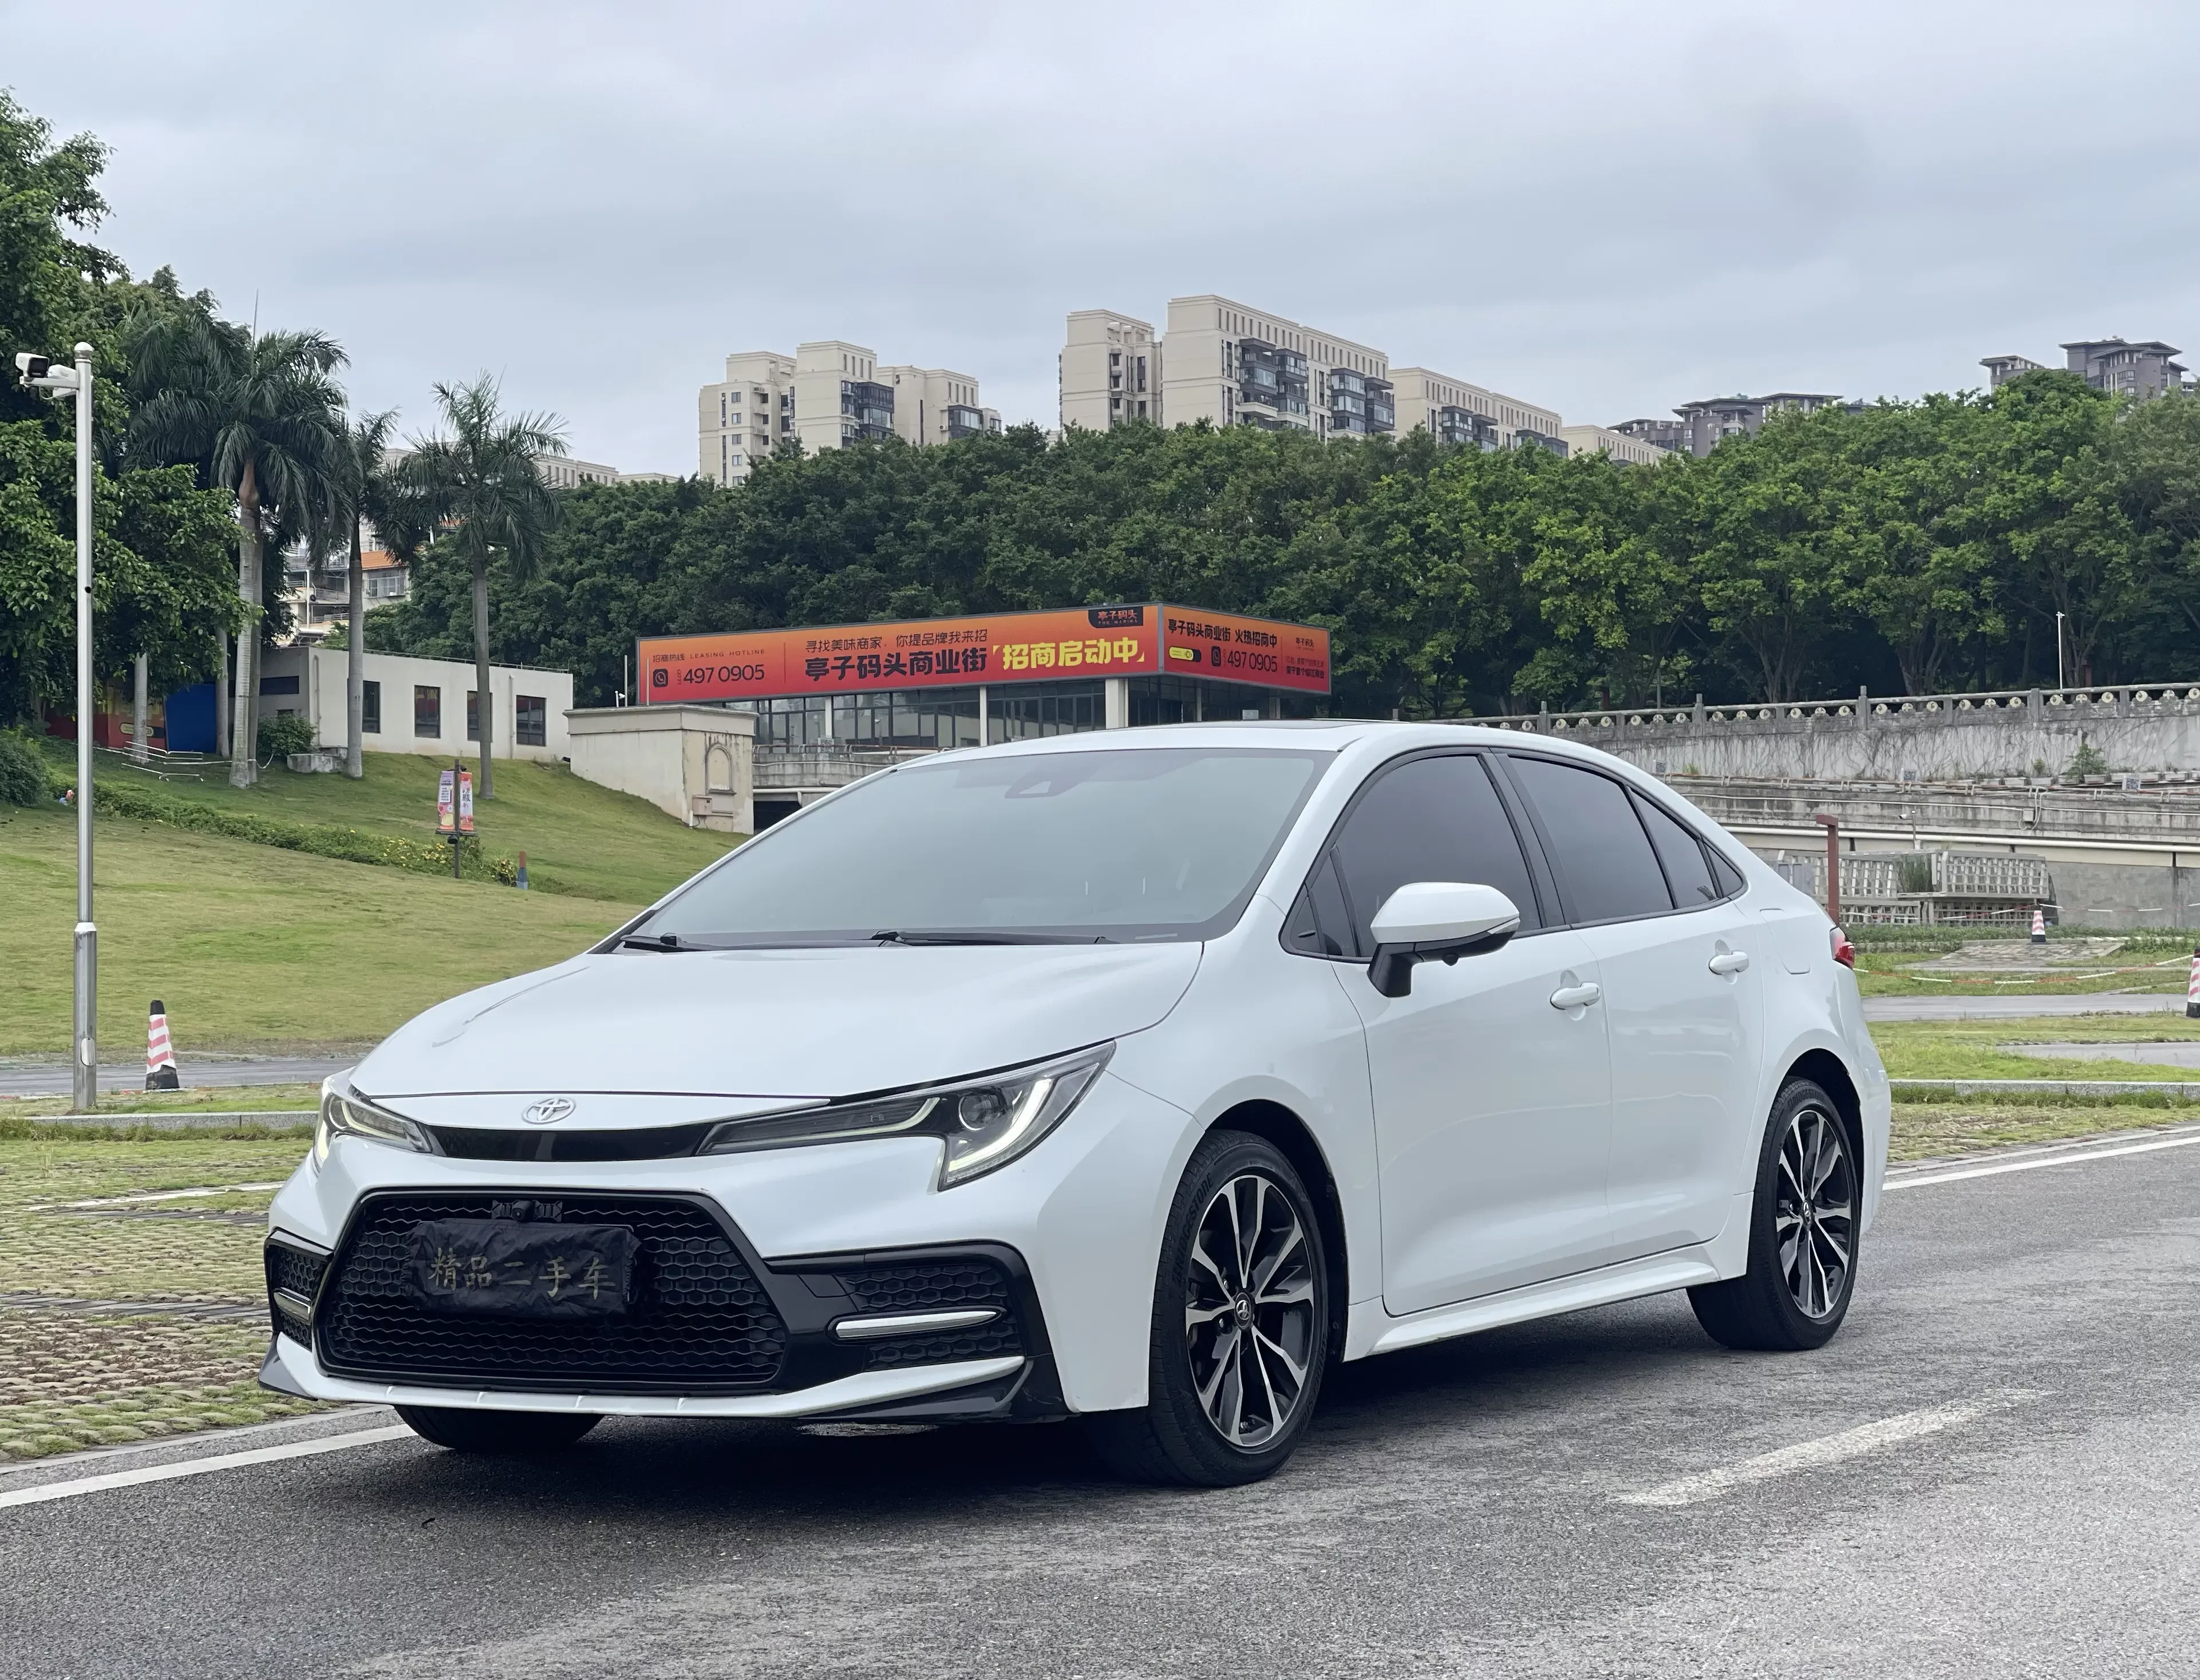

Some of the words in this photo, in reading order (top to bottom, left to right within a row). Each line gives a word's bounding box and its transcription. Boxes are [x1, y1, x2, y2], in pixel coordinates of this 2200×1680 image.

[1097, 610, 1137, 620] 亭子码头
[896, 628, 988, 647] 你提品牌我来招
[1168, 619, 1230, 642] 亭子码头商业街
[1235, 628, 1277, 648] 火热招商中
[653, 653, 685, 662] 招商热线
[729, 649, 765, 657] HOTLINE
[805, 647, 988, 682] 亭子码头商业街
[428, 1247, 617, 1300] 精品二手车
